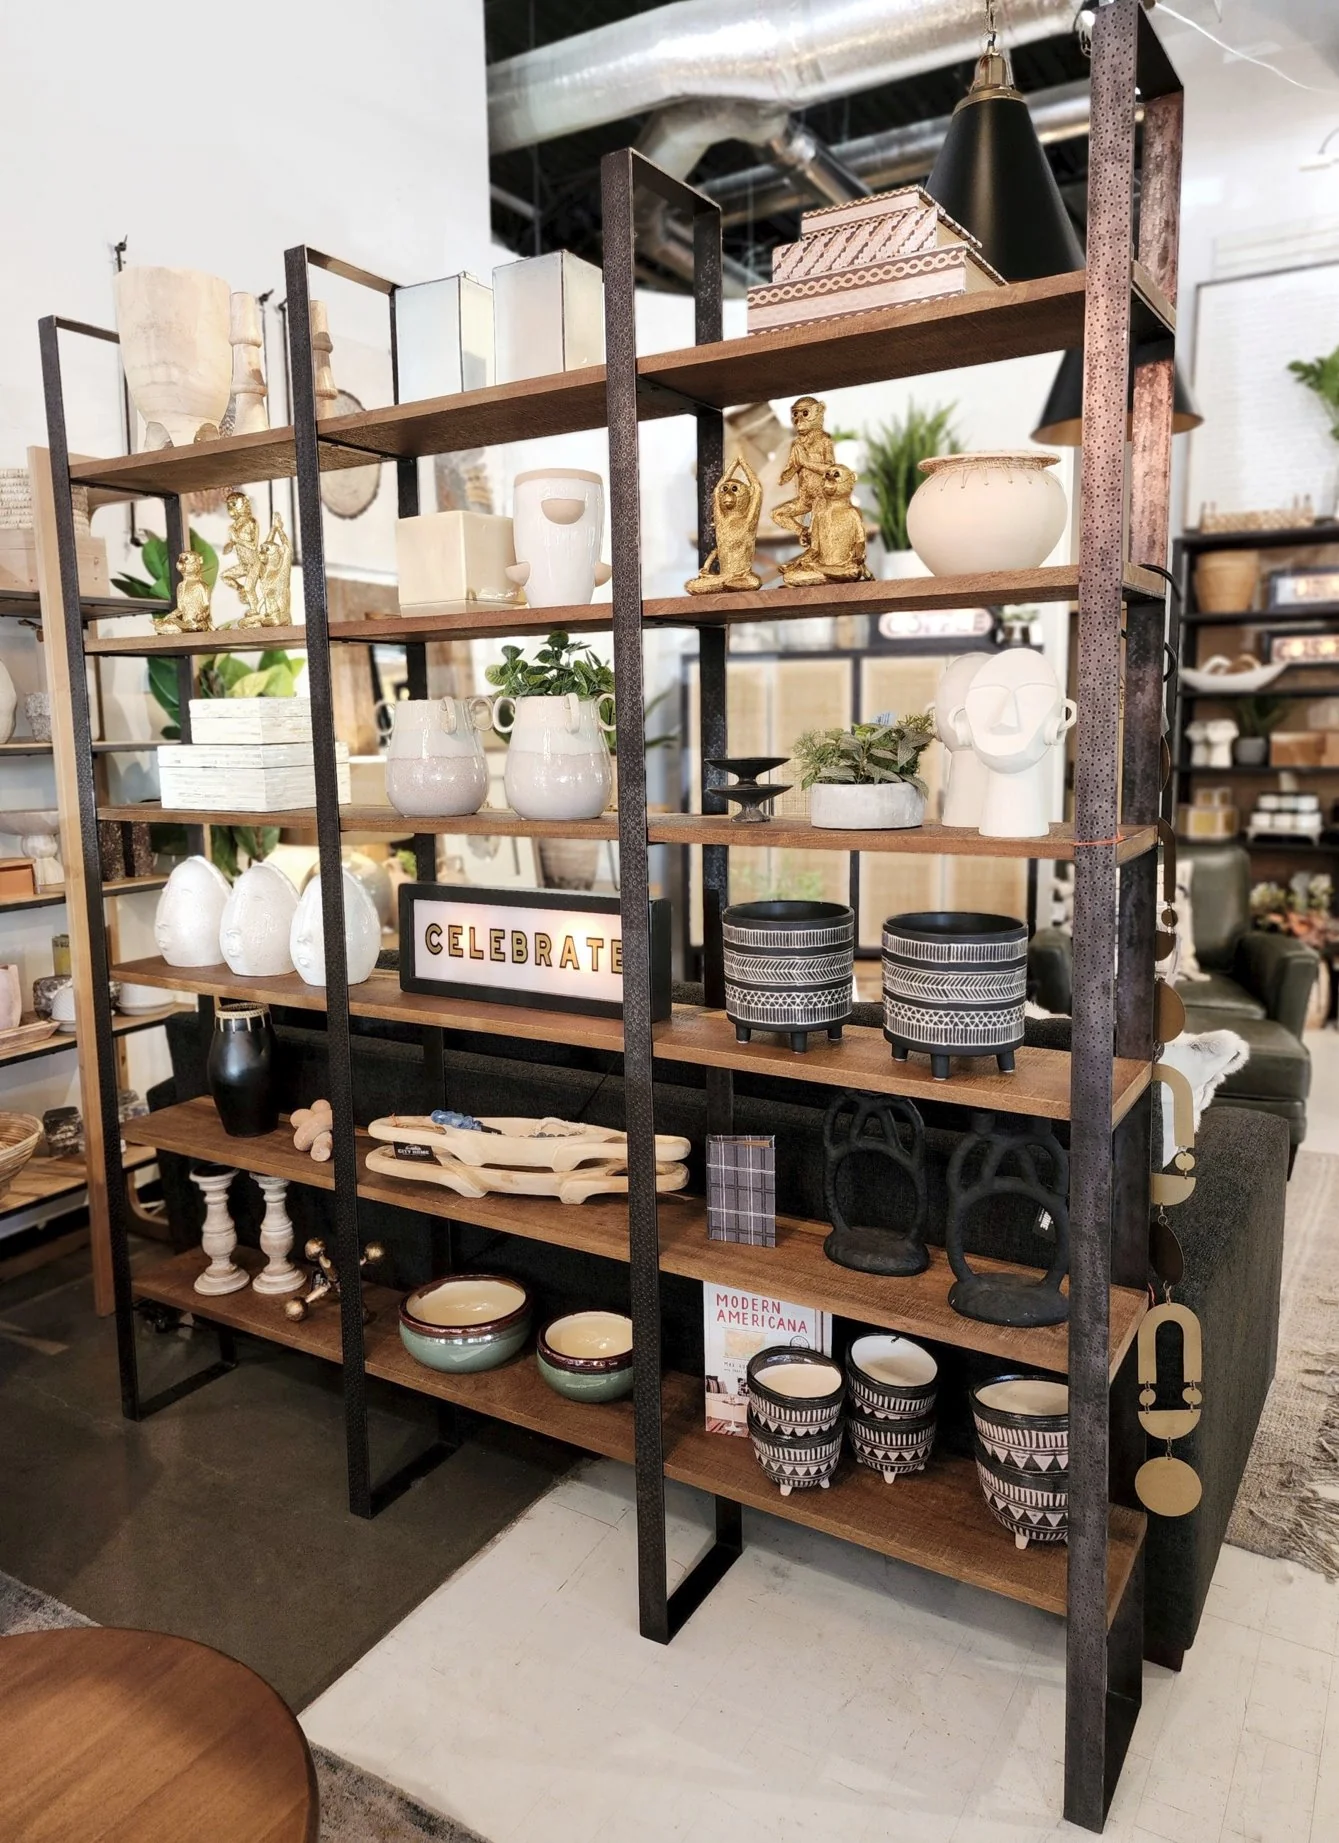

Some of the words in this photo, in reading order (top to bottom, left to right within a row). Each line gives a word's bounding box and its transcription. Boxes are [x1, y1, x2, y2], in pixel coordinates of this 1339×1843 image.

[425, 922, 623, 975] CELEBRATE
[716, 1293, 781, 1315] MODERN
[716, 1309, 808, 1334] AMERICANA
